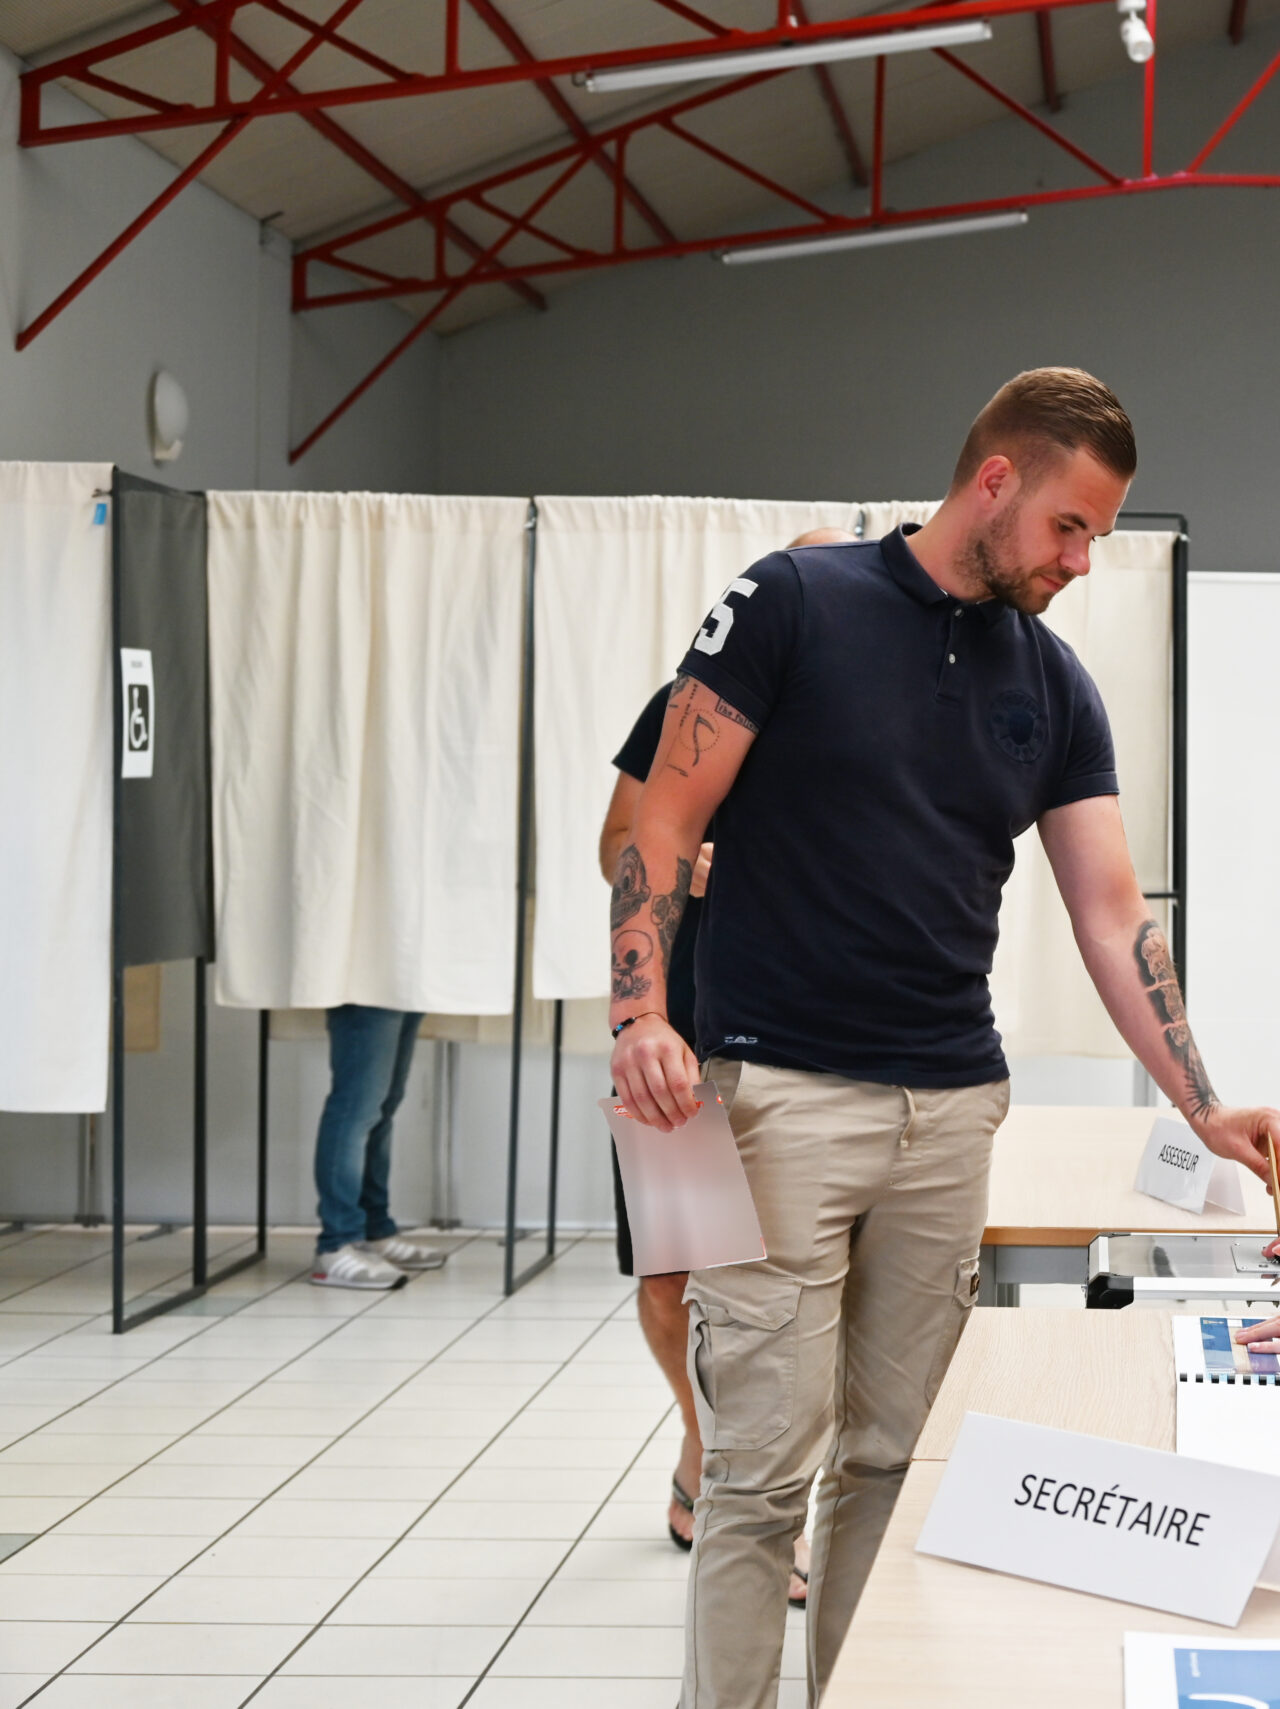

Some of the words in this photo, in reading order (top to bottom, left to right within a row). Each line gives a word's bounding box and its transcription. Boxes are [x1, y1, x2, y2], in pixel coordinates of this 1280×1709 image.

[693, 577, 759, 656] 5
[1157, 1143, 1200, 1174] ASSESSEUR
[1013, 1473, 1211, 1547] SECRÉTAIRE
